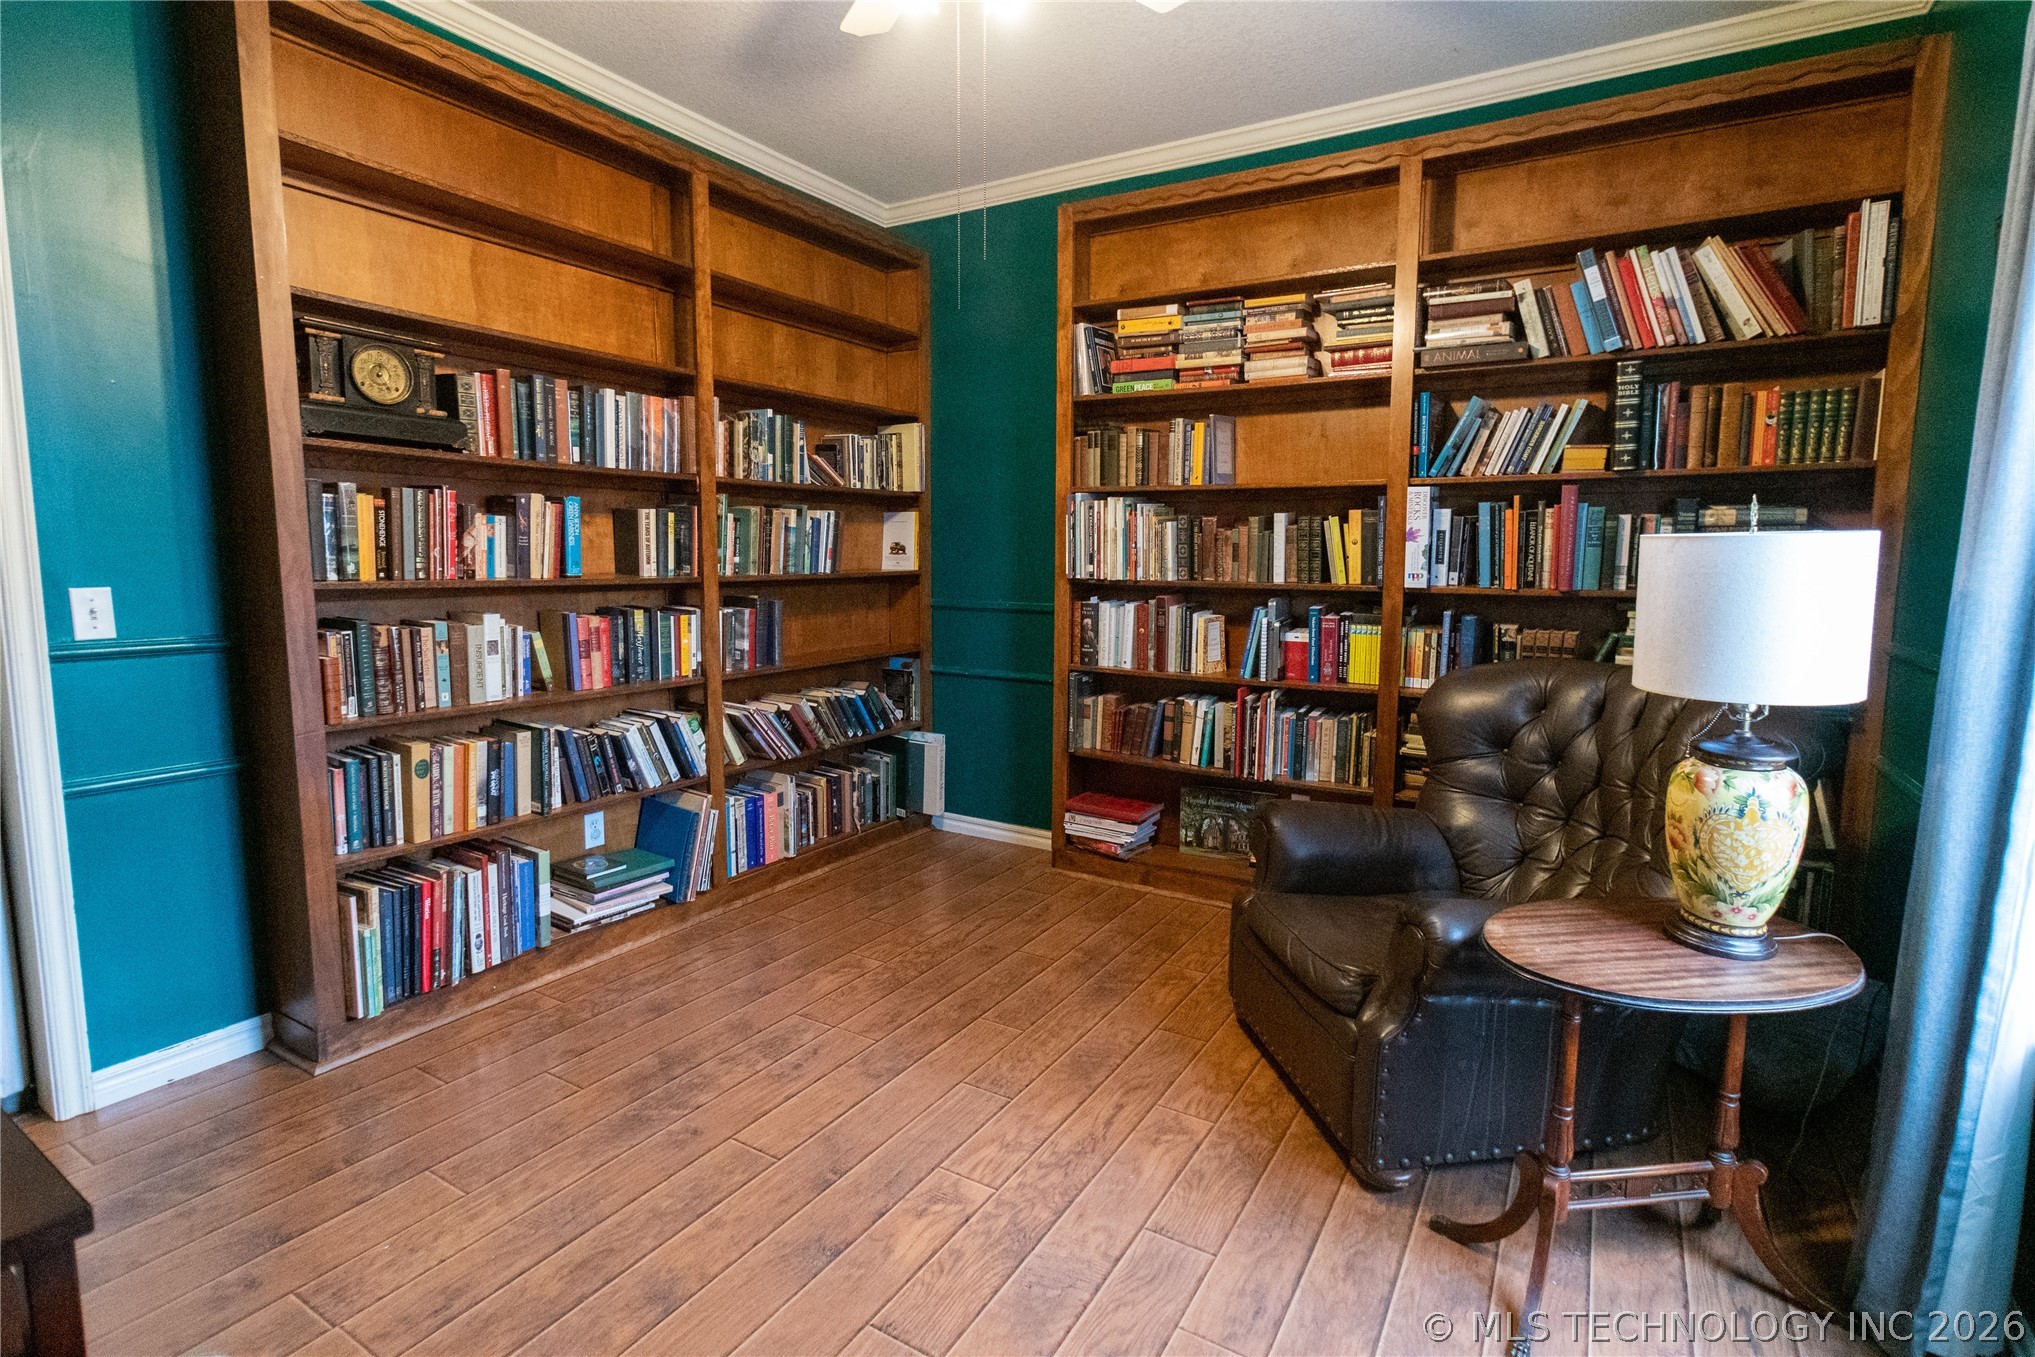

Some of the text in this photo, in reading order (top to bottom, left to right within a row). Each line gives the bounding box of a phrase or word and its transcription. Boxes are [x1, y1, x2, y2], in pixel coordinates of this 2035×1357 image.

[1643, 265, 1660, 300] Herbs
[1433, 350, 1481, 362] ANIMAL
[1115, 382, 1153, 393] GREENPEACE
[1413, 491, 1422, 521] ROCKS
[378, 510, 387, 547] STONEHENGE
[1529, 521, 1537, 545] ELEANOR
[1526, 554, 1535, 582] AQUITAINE
[475, 643, 484, 690] INSURGENT
